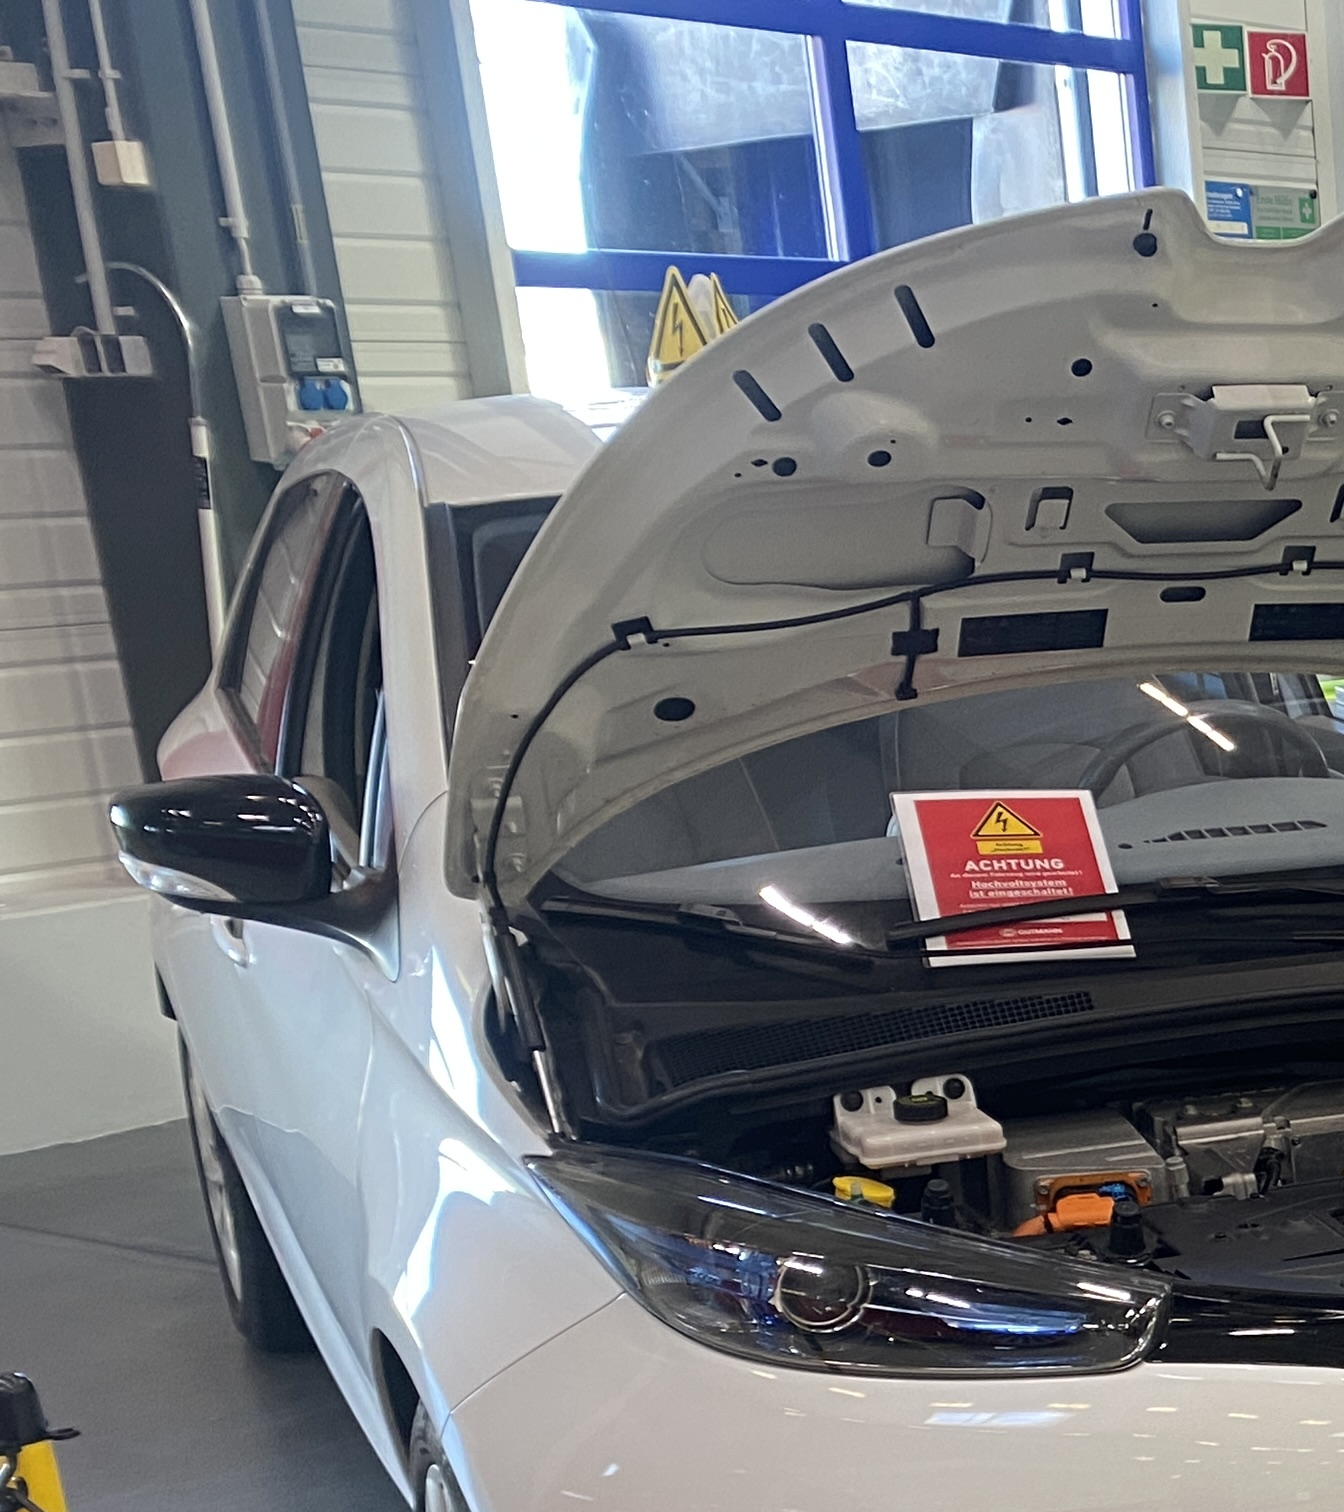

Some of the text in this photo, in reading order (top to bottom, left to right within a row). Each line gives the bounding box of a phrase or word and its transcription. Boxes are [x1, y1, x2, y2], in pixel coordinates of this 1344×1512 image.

[965, 858, 1064, 872] ACHTUNG
[971, 880, 1067, 889] Hochvoltsystem
[969, 889, 985, 899] ist
